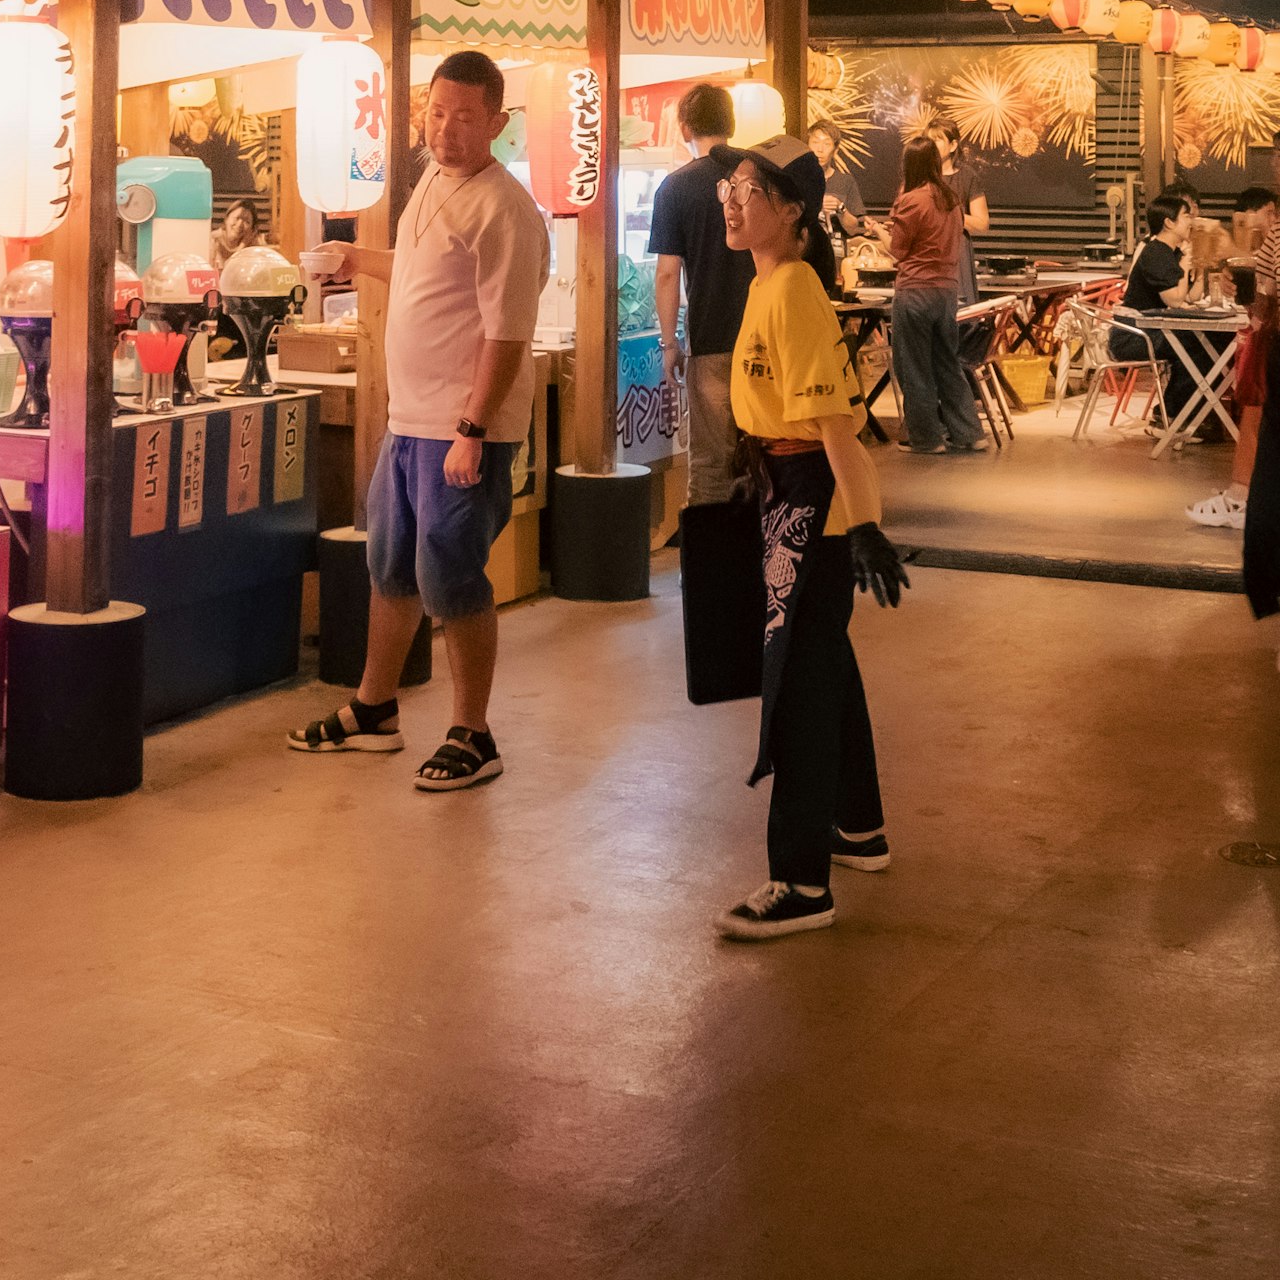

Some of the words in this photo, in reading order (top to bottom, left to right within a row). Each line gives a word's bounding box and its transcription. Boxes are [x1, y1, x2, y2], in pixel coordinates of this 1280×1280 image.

[354, 71, 386, 140] 氷
[276, 273, 297, 285] メロン
[144, 430, 161, 499] イチゴ
[285, 404, 298, 470] メロン
